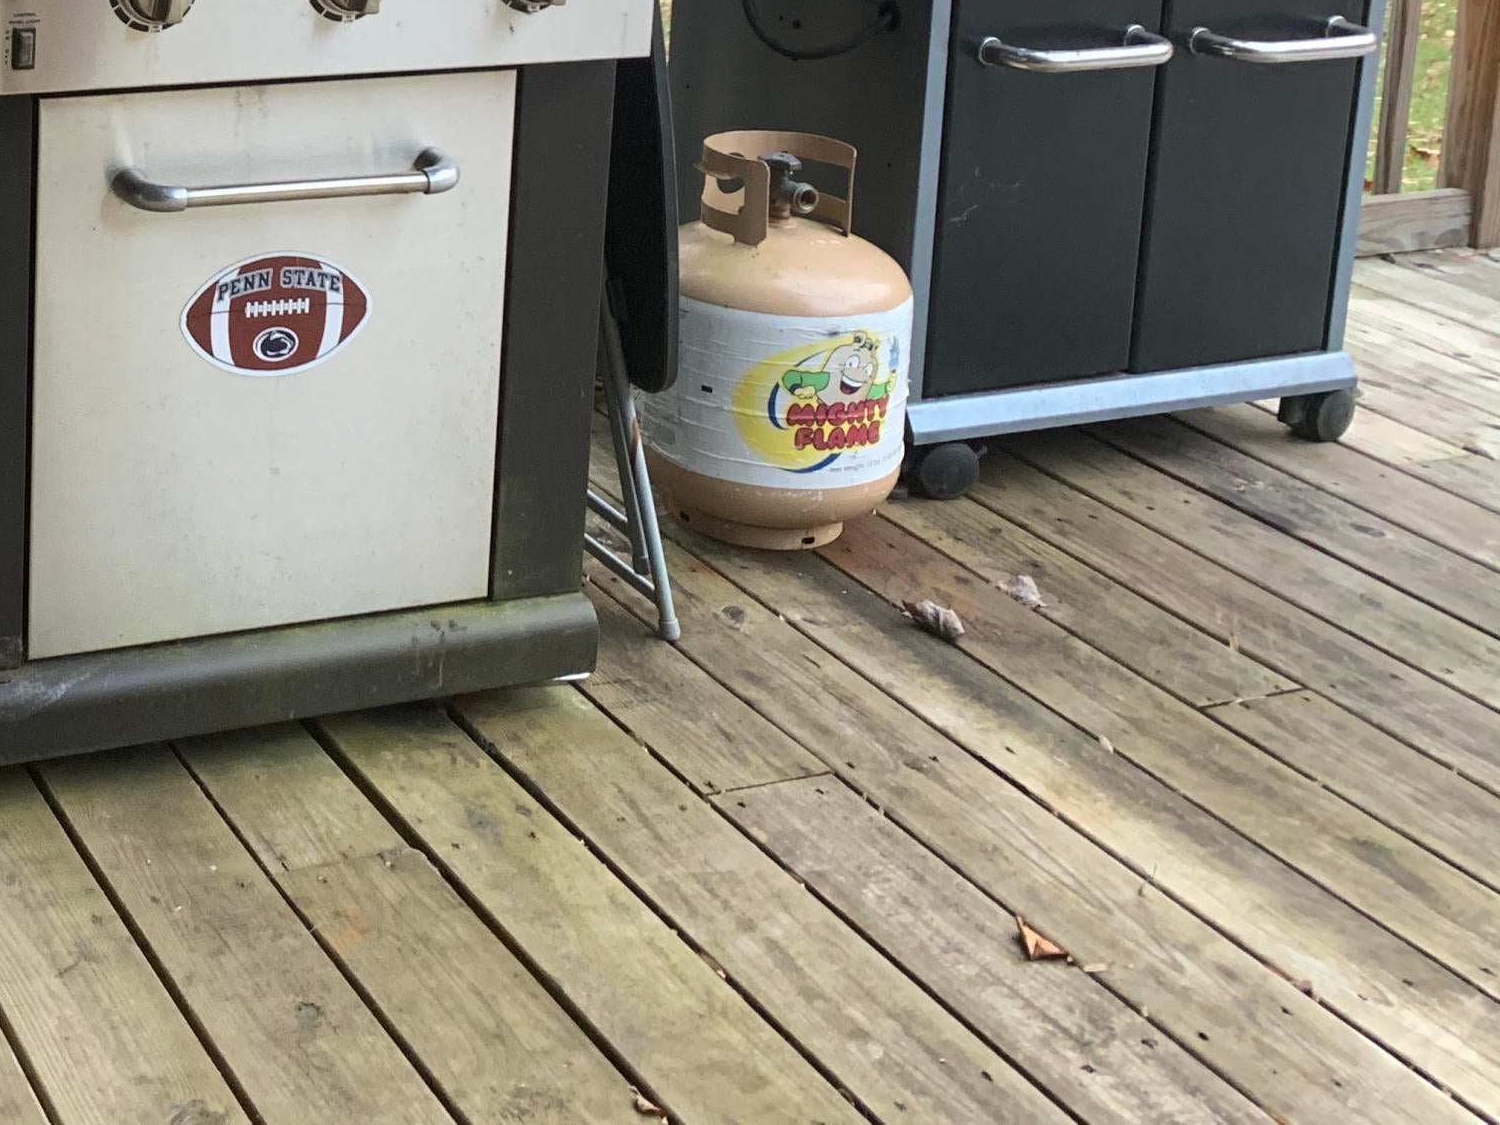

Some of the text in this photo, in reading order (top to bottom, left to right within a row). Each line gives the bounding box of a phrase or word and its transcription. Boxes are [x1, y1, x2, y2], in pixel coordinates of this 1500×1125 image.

[216, 268, 342, 302] PENN STATE
[785, 393, 889, 427] MIGHTY
[794, 420, 881, 451] FLAME
